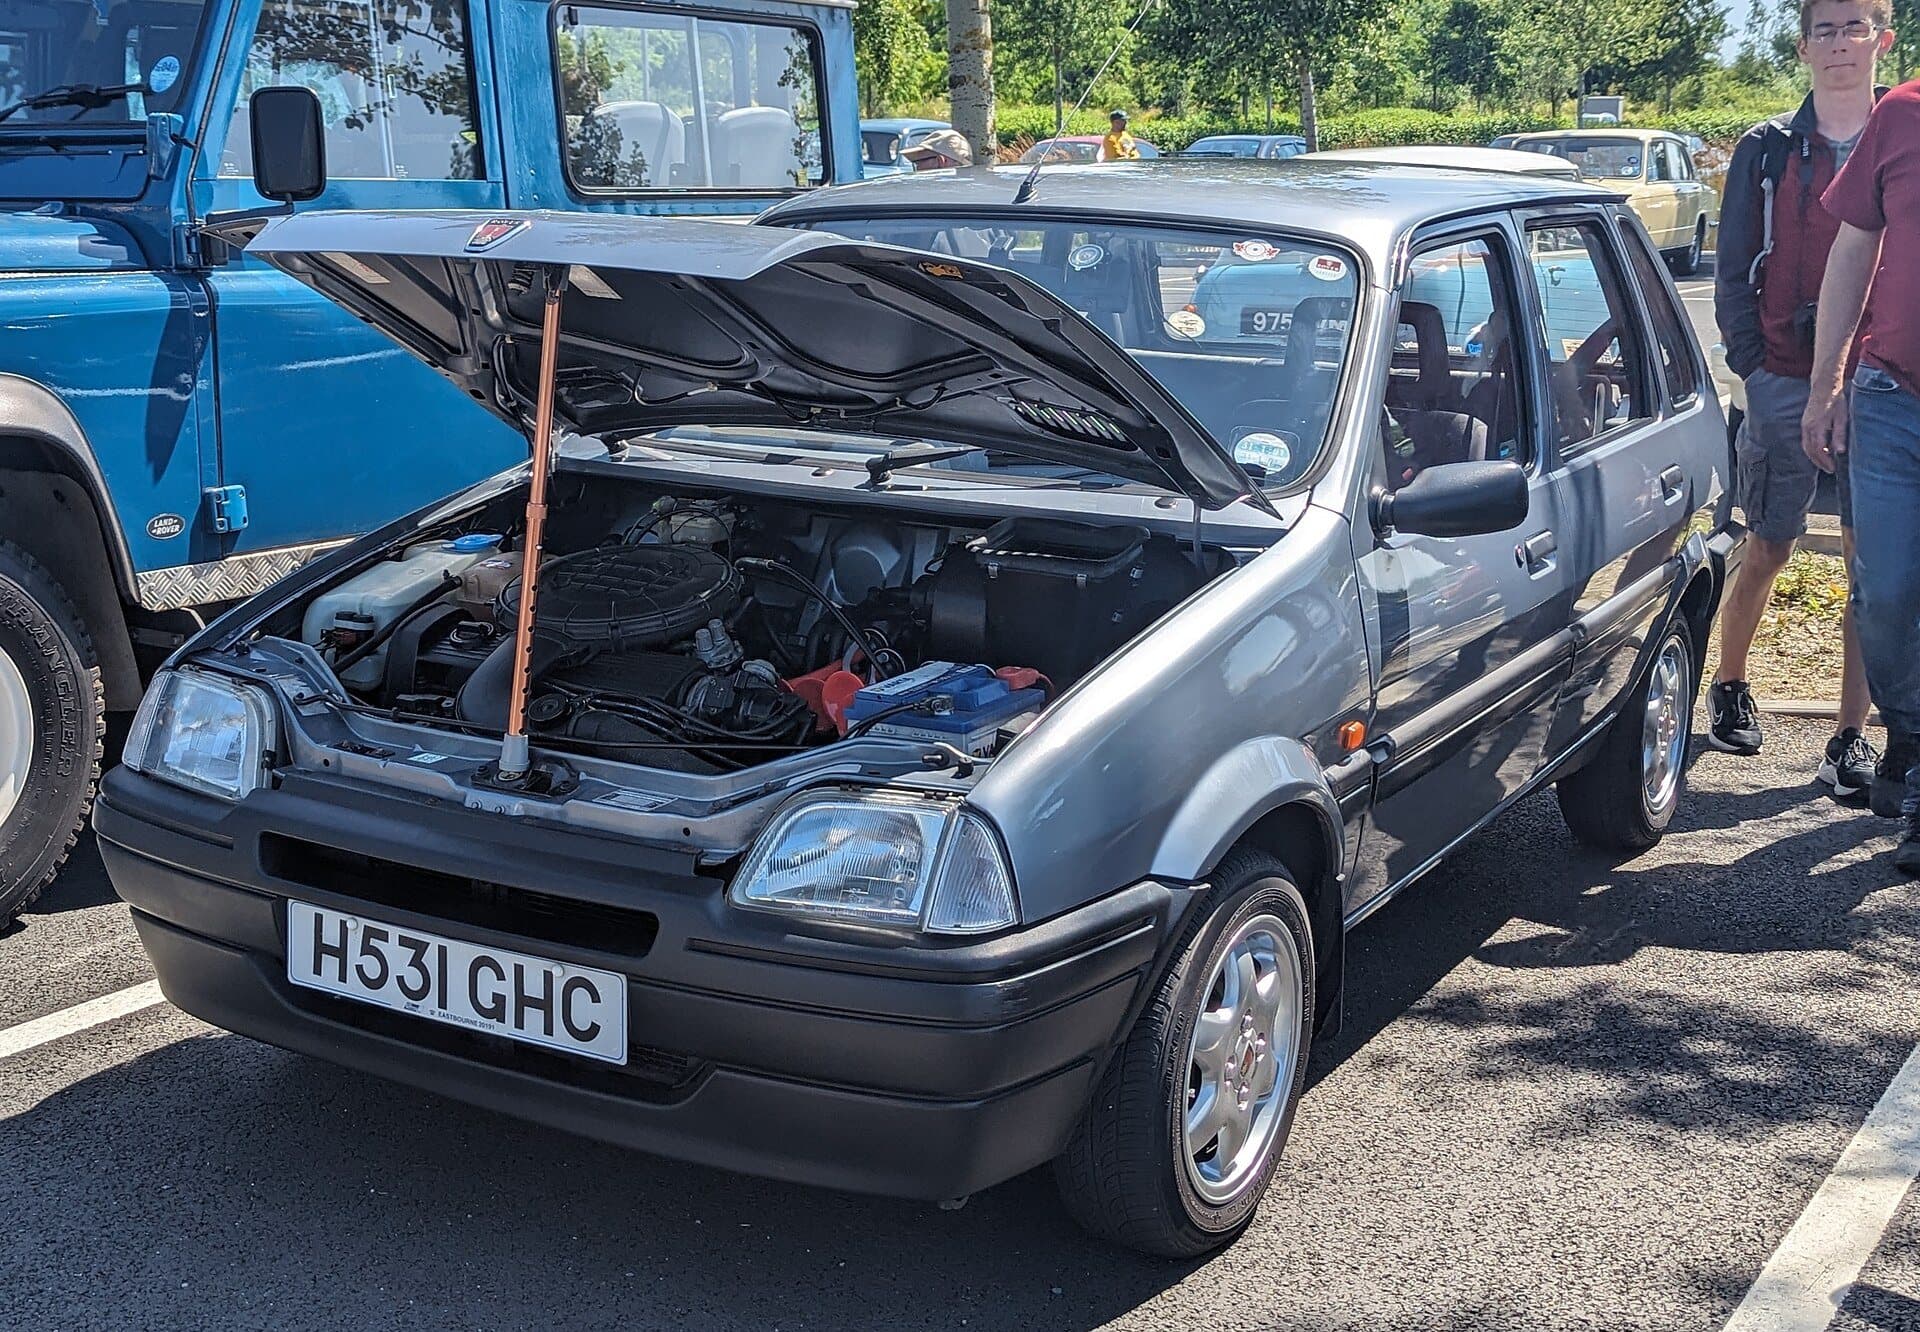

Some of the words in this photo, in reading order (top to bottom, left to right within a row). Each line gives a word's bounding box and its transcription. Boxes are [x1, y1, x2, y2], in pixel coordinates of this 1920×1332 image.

[1253, 312, 1293, 331] 975
[154, 518, 174, 528] LAND
[156, 524, 180, 535] ROVER
[313, 912, 448, 1011] H531
[468, 934, 602, 1043] GHC
[438, 1011, 478, 1027] EASTBOURNE
